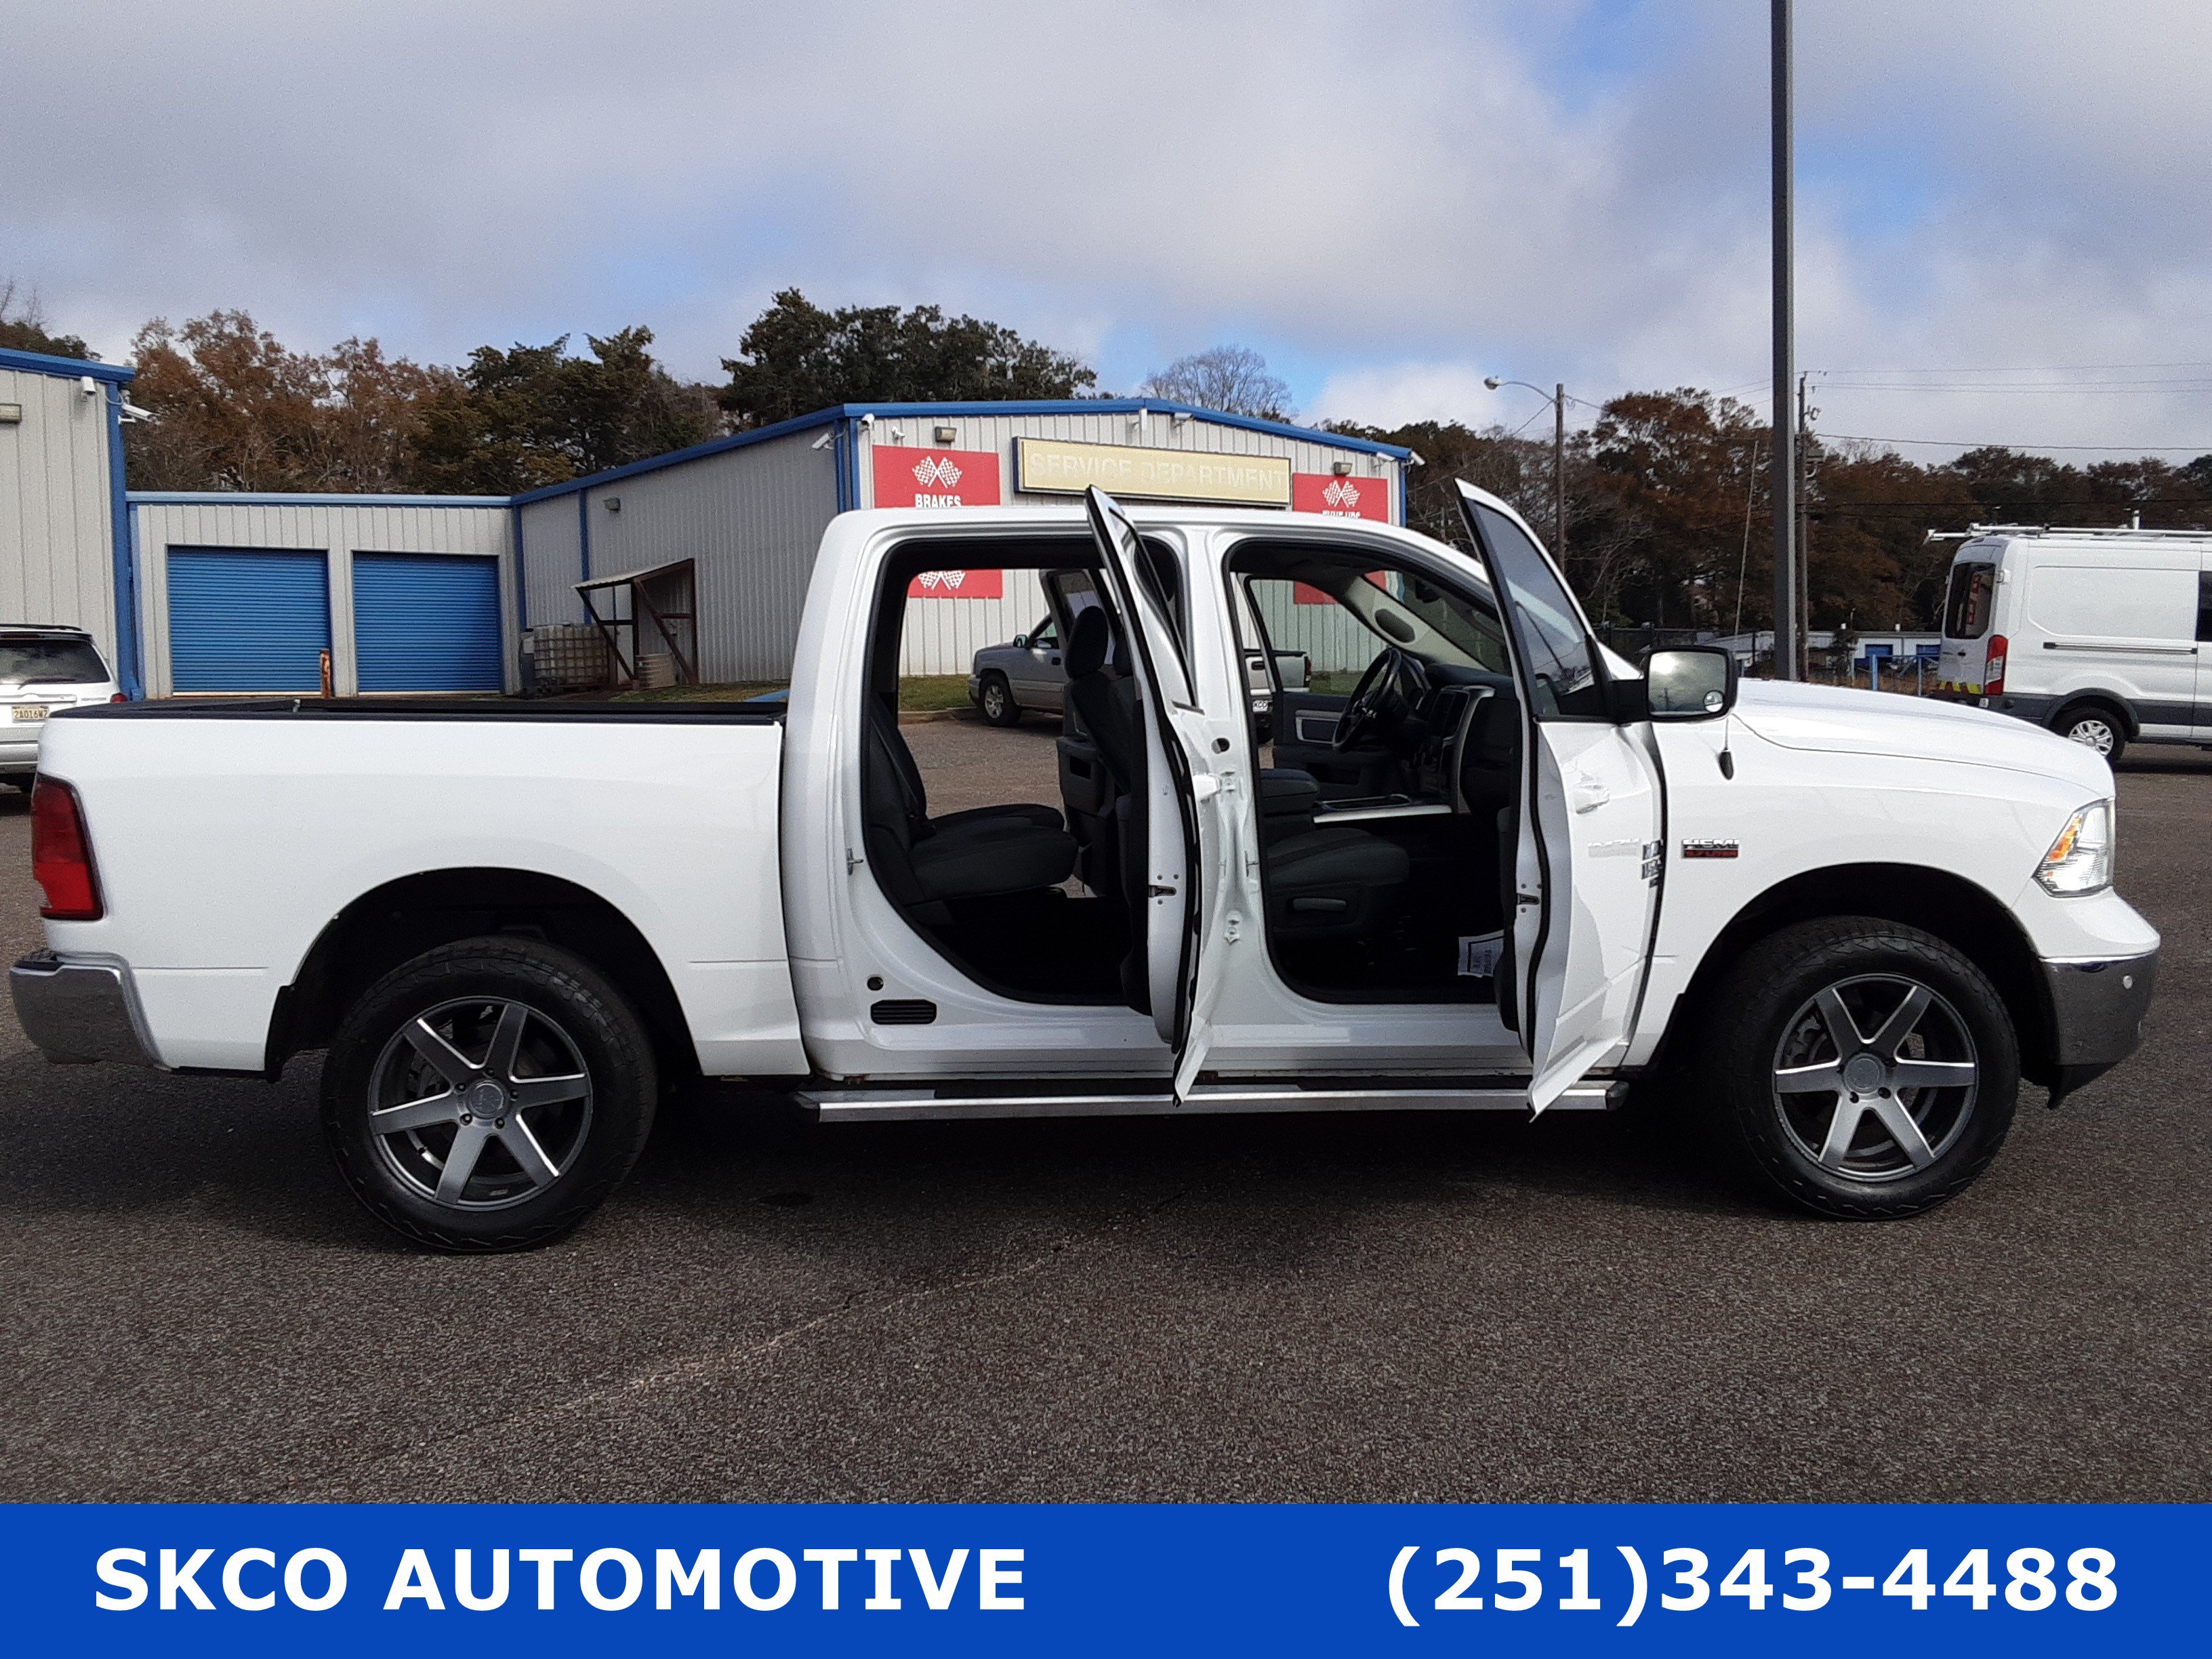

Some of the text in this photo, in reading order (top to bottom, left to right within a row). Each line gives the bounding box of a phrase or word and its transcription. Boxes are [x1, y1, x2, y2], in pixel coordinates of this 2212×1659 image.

[1029, 453, 1288, 490] SERVICE DEPARTMENT
[915, 493, 962, 508] BRAKES
